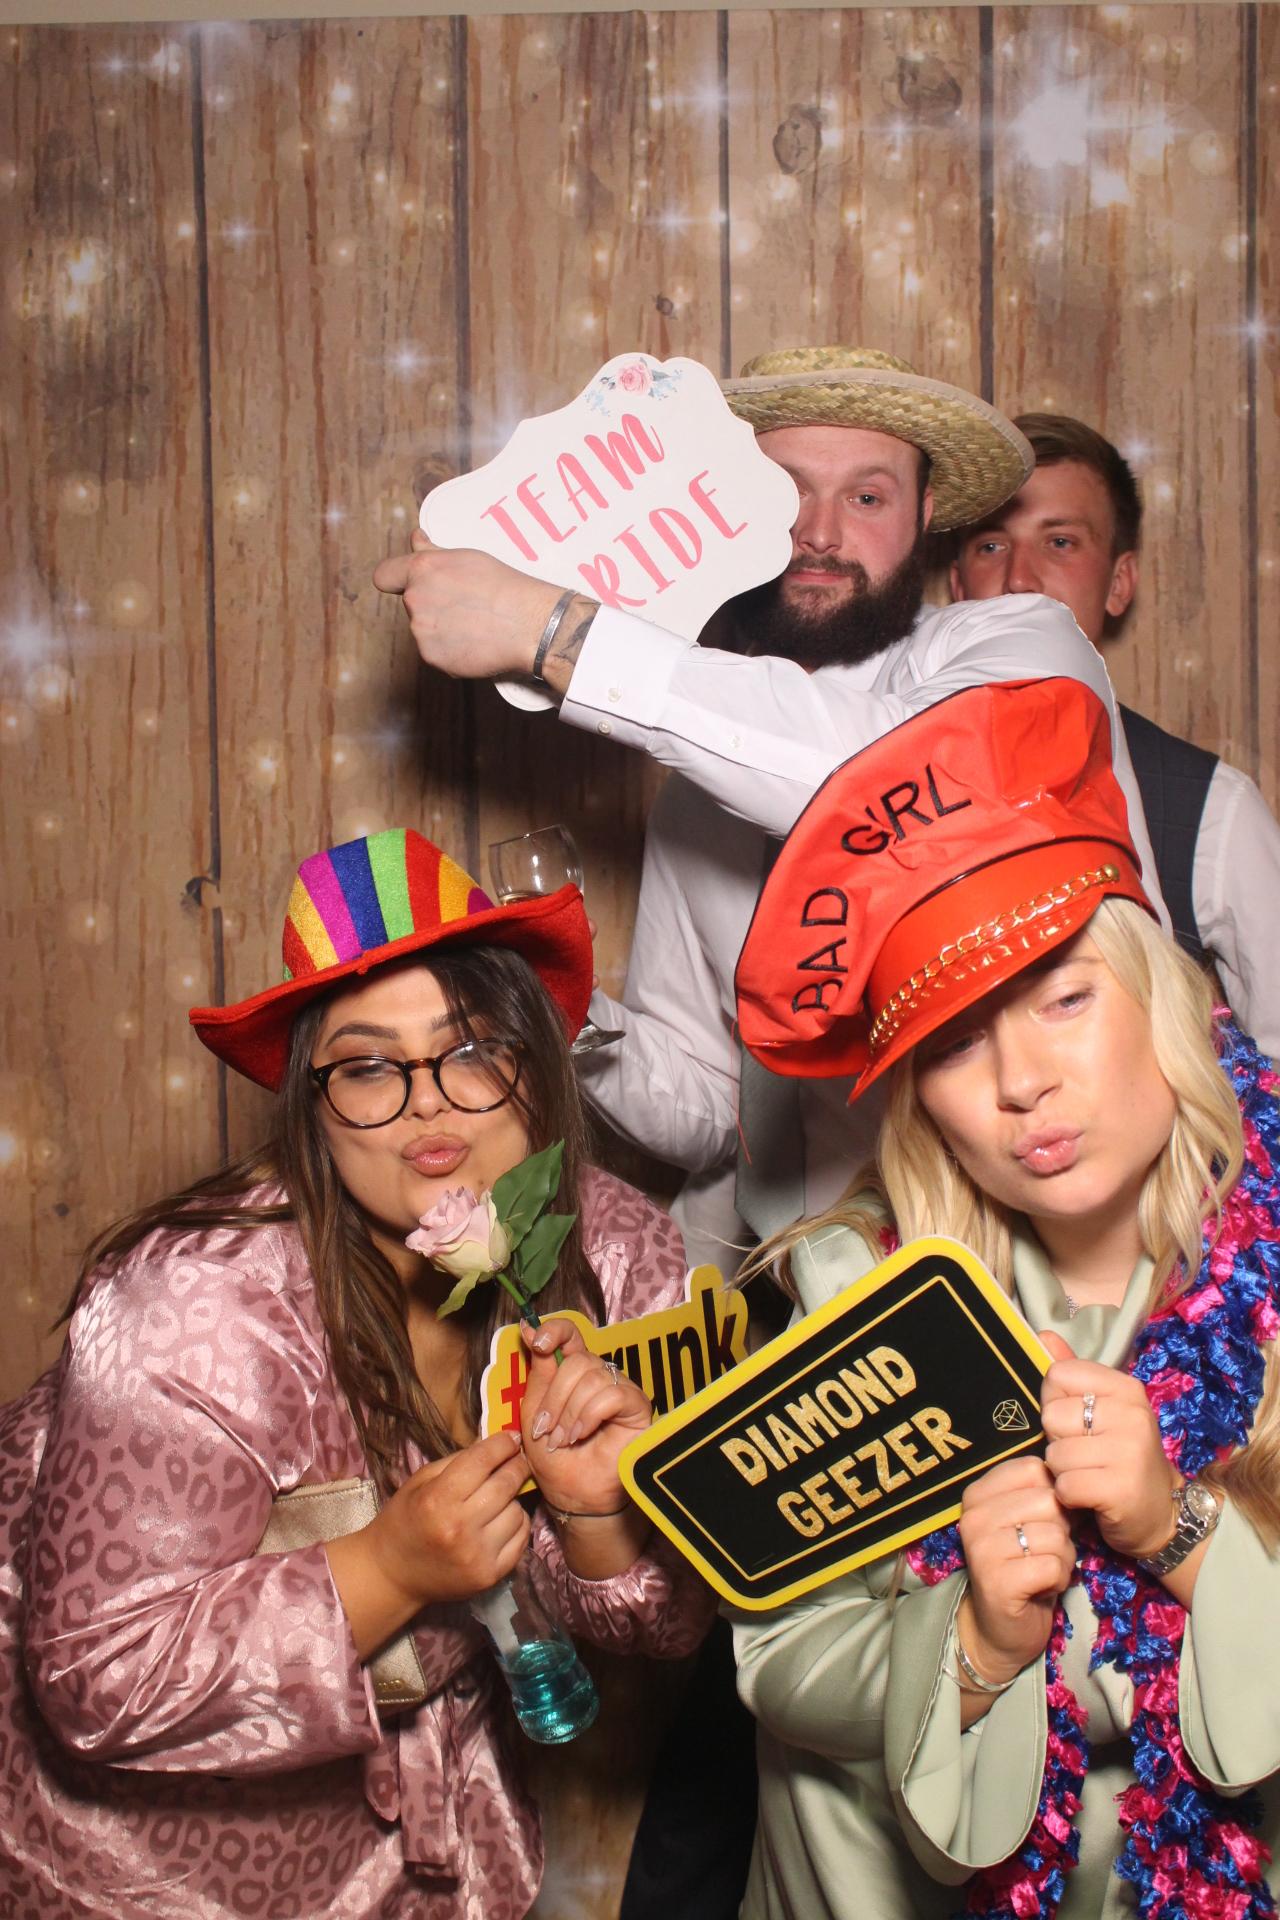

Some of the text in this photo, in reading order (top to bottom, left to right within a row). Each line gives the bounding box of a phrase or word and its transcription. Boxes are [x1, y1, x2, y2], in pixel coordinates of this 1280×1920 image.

[480, 413, 665, 562] TEAM
[577, 470, 748, 610] RIDE
[791, 886, 849, 1015] BAD
[719, 1346, 917, 1487] DIAMOND
[776, 1407, 973, 1538] GEEZER
